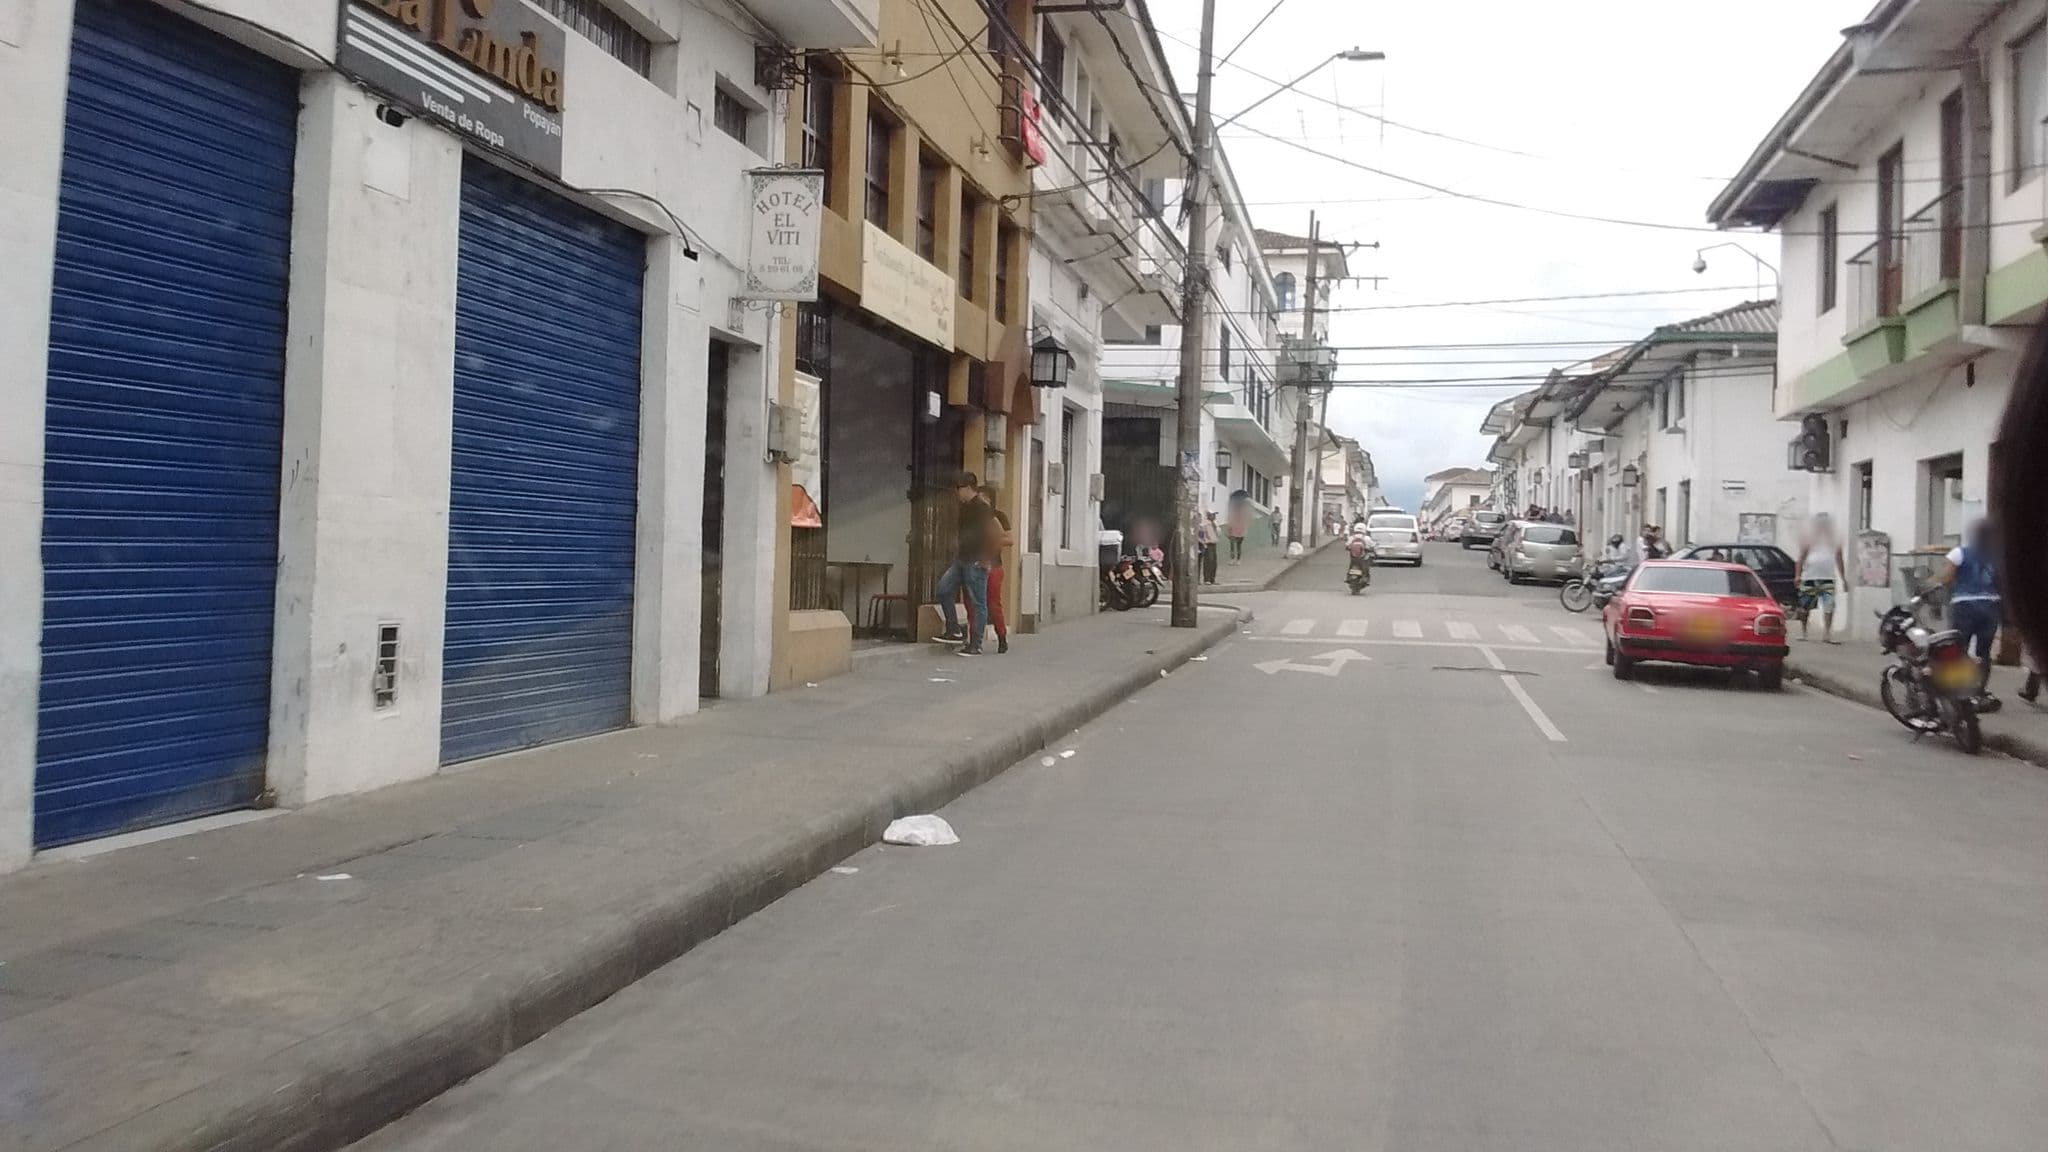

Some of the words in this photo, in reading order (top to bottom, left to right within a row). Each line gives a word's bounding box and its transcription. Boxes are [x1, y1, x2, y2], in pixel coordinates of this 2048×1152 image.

[421, 91, 456, 123] Venta
[457, 110, 473, 131] de
[475, 121, 505, 147] Ropa
[523, 103, 561, 136] Popayán
[756, 191, 814, 216] HOTEL
[774, 213, 795, 228] EL
[766, 229, 800, 246] VITI
